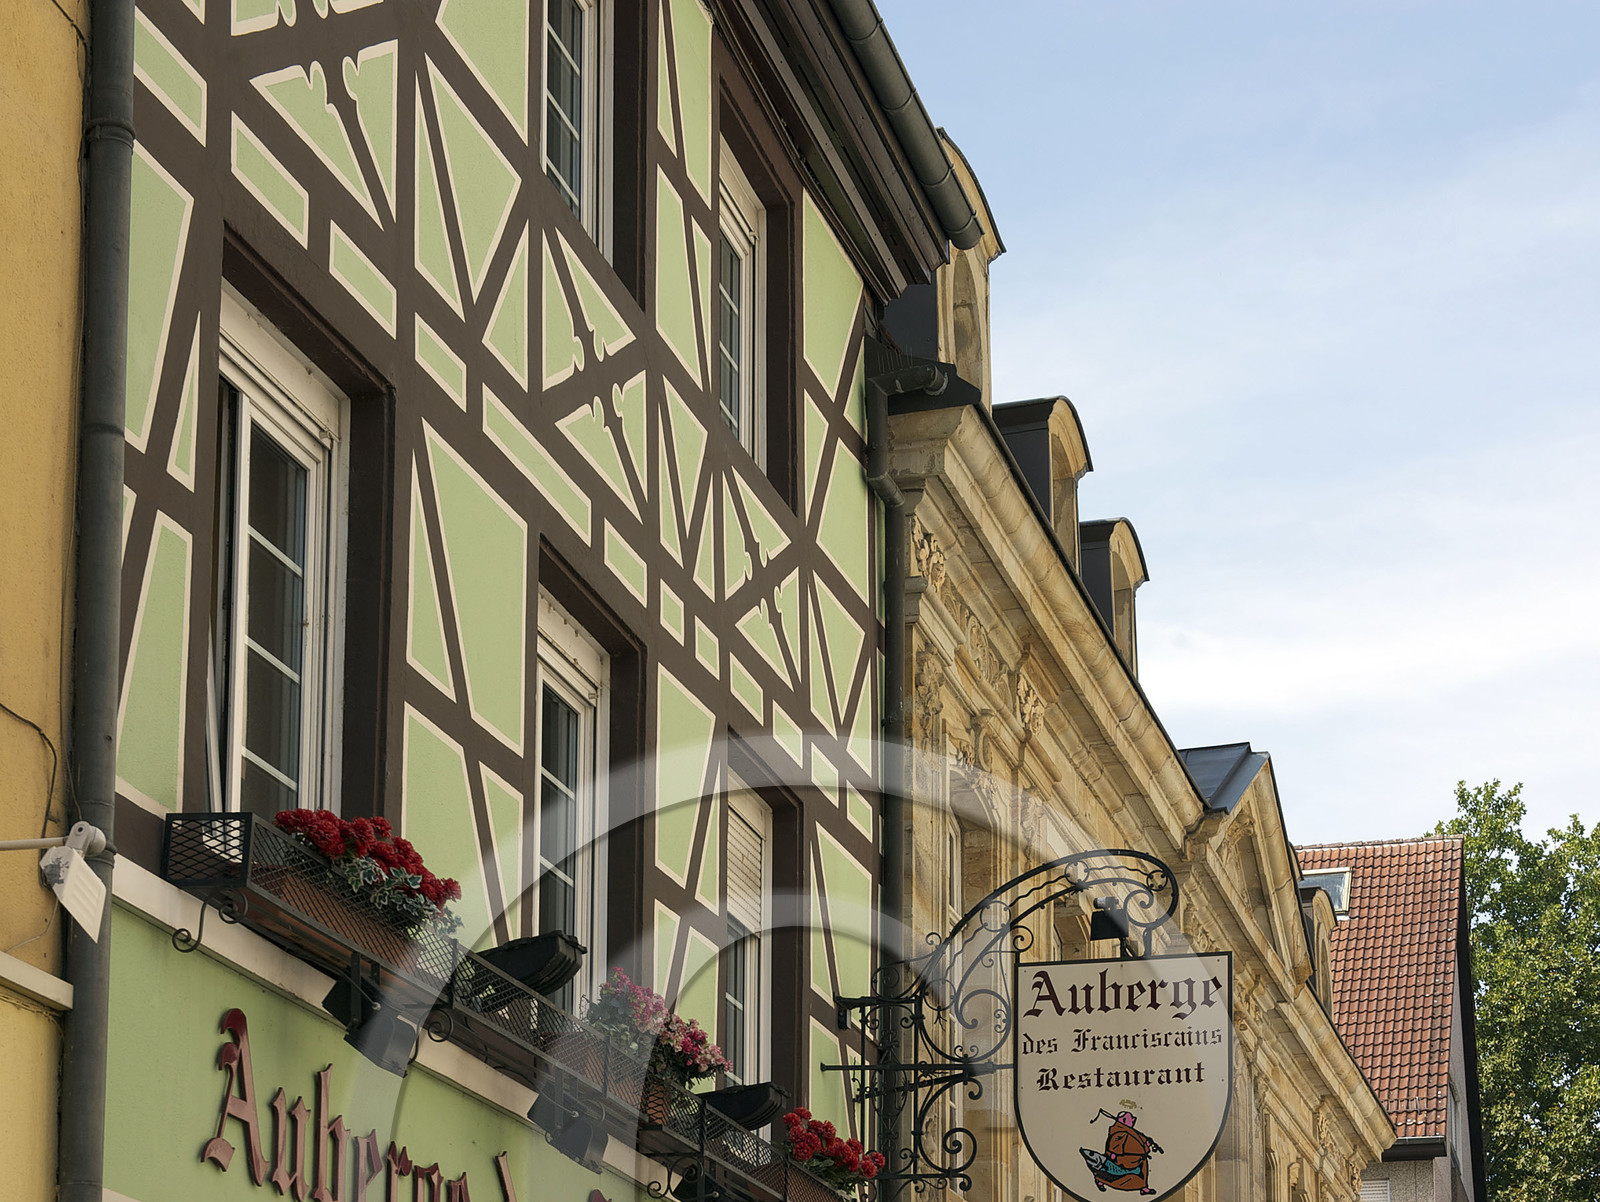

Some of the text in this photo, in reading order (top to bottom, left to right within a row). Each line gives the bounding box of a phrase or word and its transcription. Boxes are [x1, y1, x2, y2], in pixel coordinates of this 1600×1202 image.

[1023, 968, 1223, 1020] Auberge
[1022, 1026, 1223, 1055] des Franciscains
[1036, 1062, 1206, 1091] Restaurant
